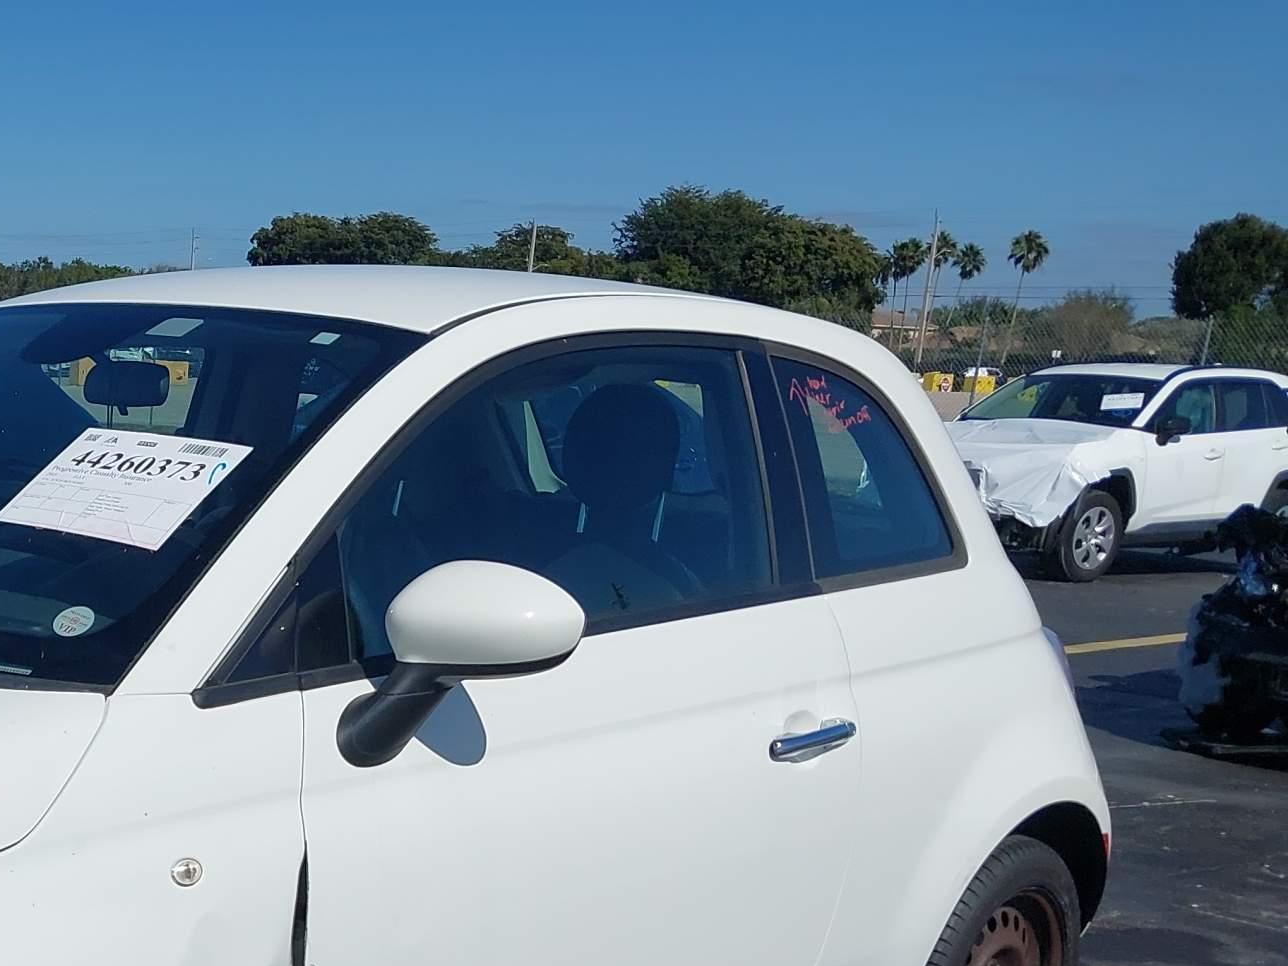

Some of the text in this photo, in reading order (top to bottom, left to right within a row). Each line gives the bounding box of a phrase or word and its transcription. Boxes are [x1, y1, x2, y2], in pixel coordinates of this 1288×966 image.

[51, 465, 90, 477] Progressive
[90, 469, 118, 479] Casualty
[118, 473, 153, 483] Insurance
[71, 449, 207, 482] 44260373
[59, 622, 77, 634] VIP
